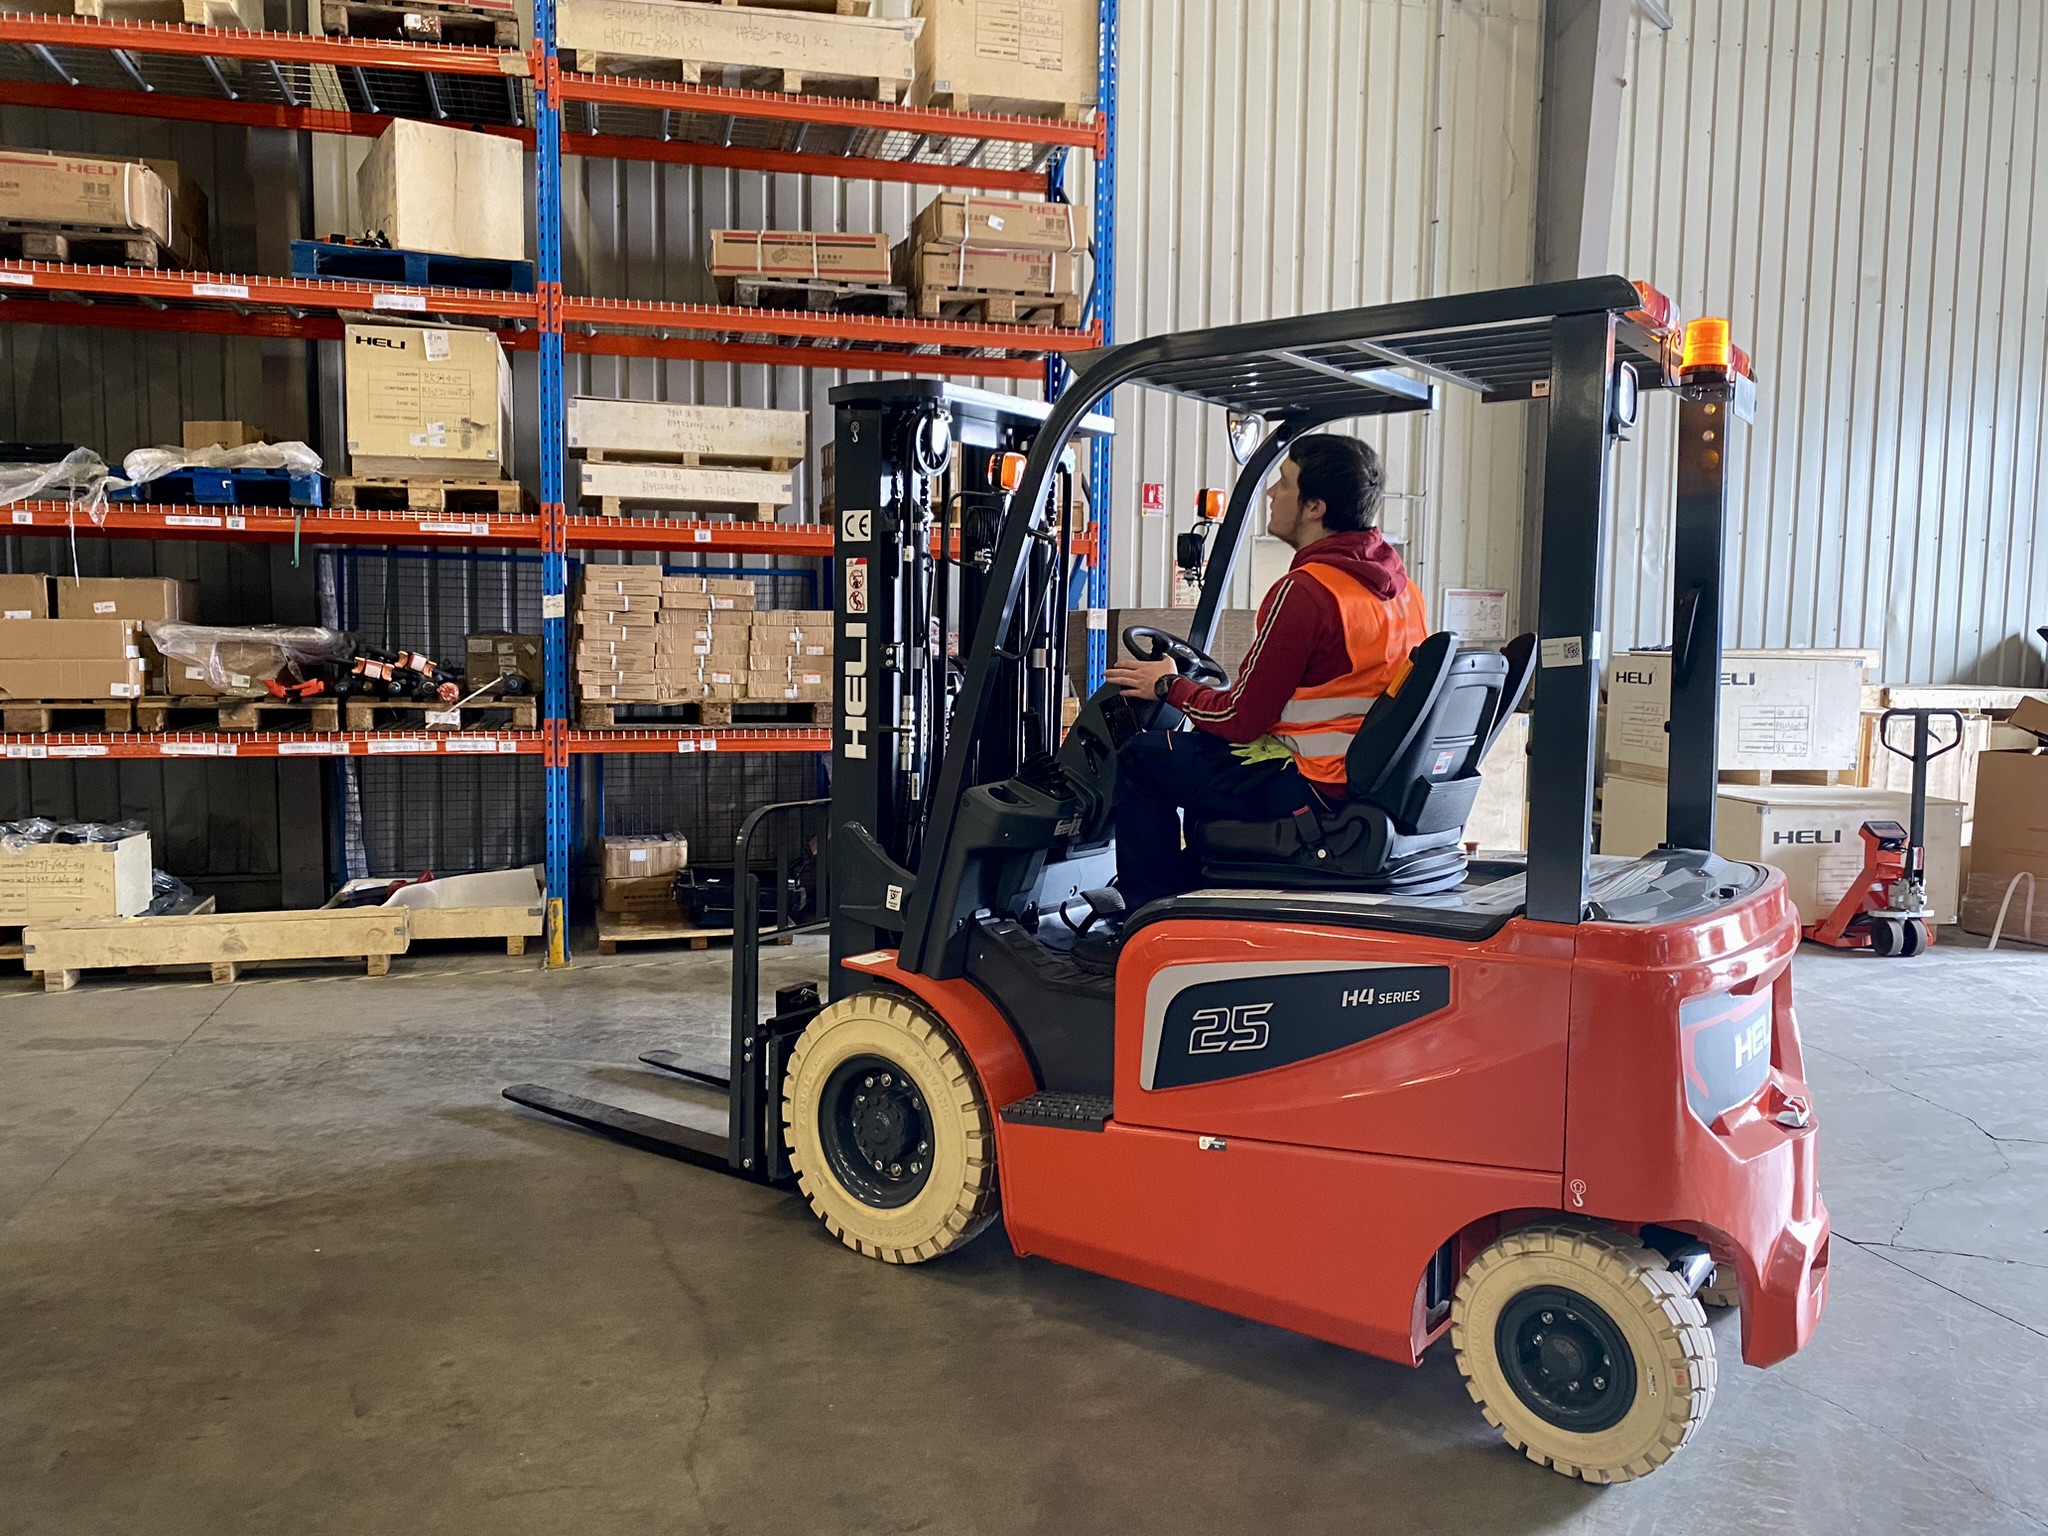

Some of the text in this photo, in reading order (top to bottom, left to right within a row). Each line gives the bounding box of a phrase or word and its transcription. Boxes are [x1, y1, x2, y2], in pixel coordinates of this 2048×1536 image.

[66, 163, 118, 176] HELI
[356, 335, 406, 350] HELI
[845, 514, 869, 538] CE
[1615, 671, 1654, 686] HELI
[1720, 672, 1757, 686] ELI
[845, 622, 868, 760] HELI
[1773, 829, 1841, 845] HELI
[1342, 988, 1421, 1008] H4 SERIES
[1188, 1002, 1274, 1055] 25
[1734, 1012, 1770, 1070] HEL
